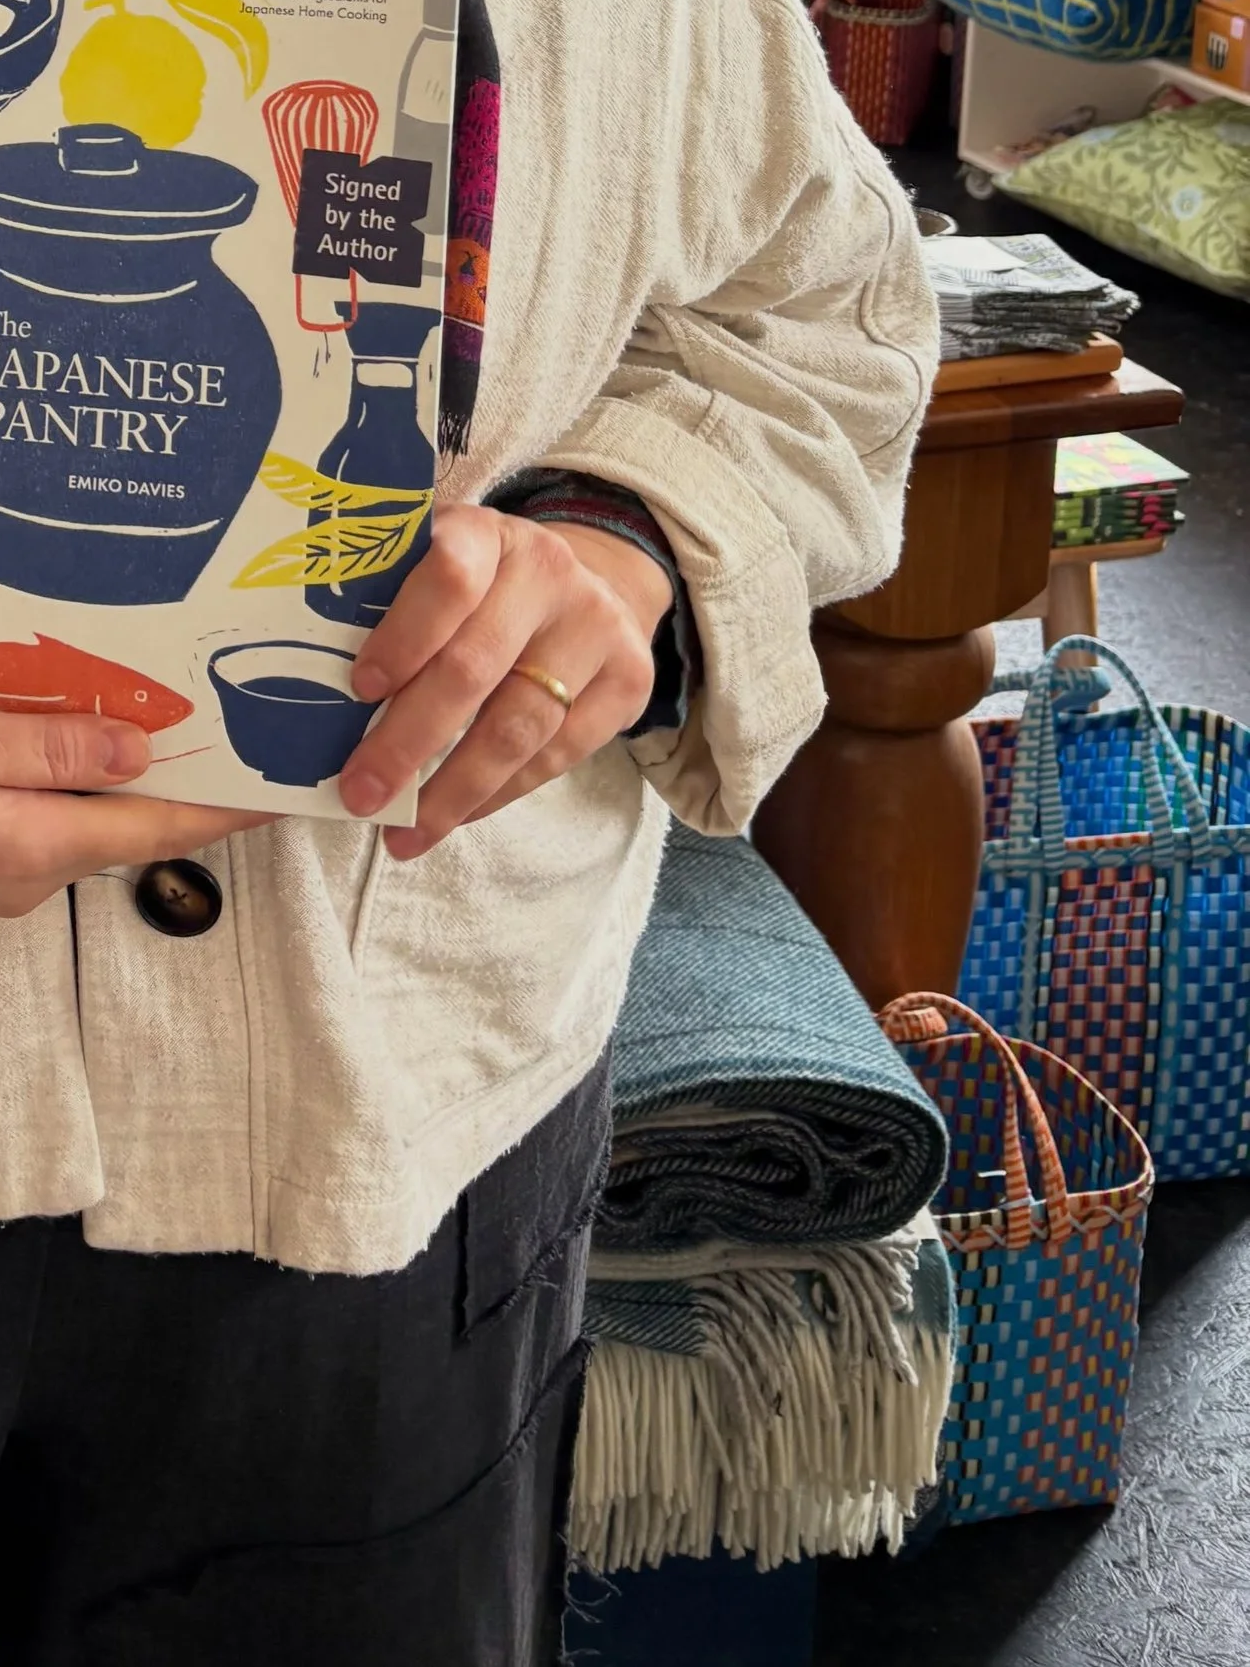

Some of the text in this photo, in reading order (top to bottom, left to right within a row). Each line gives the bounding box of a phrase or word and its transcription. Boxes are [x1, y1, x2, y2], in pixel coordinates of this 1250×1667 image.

[239, 2, 388, 24] Japanese Home Cooking
[324, 172, 402, 202] Signed
[325, 203, 396, 232] by the
[316, 233, 398, 262] Author
[68, 475, 186, 499] EMIKO DAVIES
